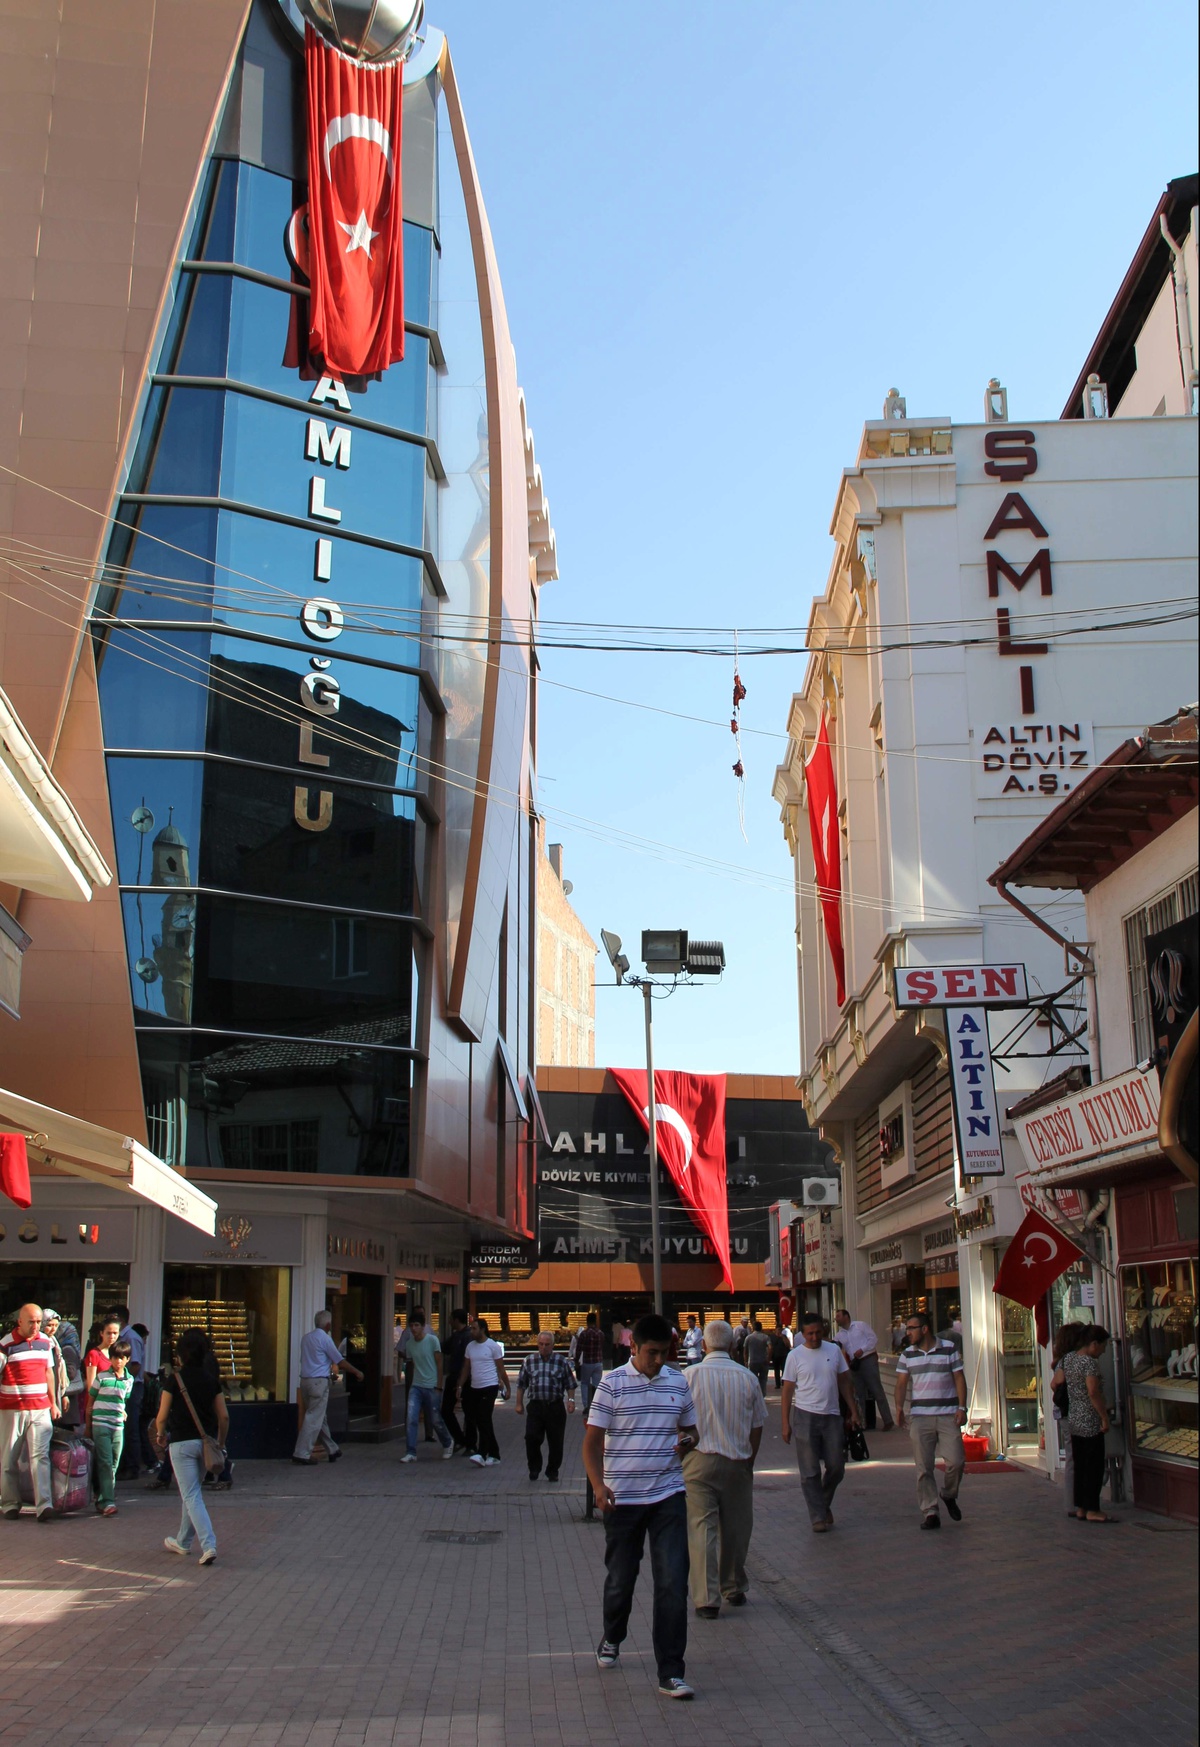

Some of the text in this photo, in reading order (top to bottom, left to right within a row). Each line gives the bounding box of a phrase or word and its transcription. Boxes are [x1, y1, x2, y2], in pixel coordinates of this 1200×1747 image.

[984, 429, 1053, 715] ŞAMLI
[294, 376, 351, 831] AMLIOĞLU
[983, 723, 1081, 745] ALTIN
[983, 745, 1089, 772] DÖVİZ
[1002, 773, 1071, 795] A.Ş.
[906, 968, 1018, 1004] ŞEN
[956, 1013, 991, 1137] ALTIN
[1078, 1076, 1159, 1146] KUYUMCU
[552, 1131, 746, 1157] AHLI
[541, 1169, 581, 1183] DÖVİZ
[584, 1173, 601, 1183] VE
[604, 1171, 665, 1183] KIYMETİ
[0, 1218, 99, 1244] ĞLU
[480, 1245, 521, 1254] ERDEM
[553, 1236, 749, 1255] AHMET KUYUMU
[471, 1255, 528, 1265] KUYUMCU
